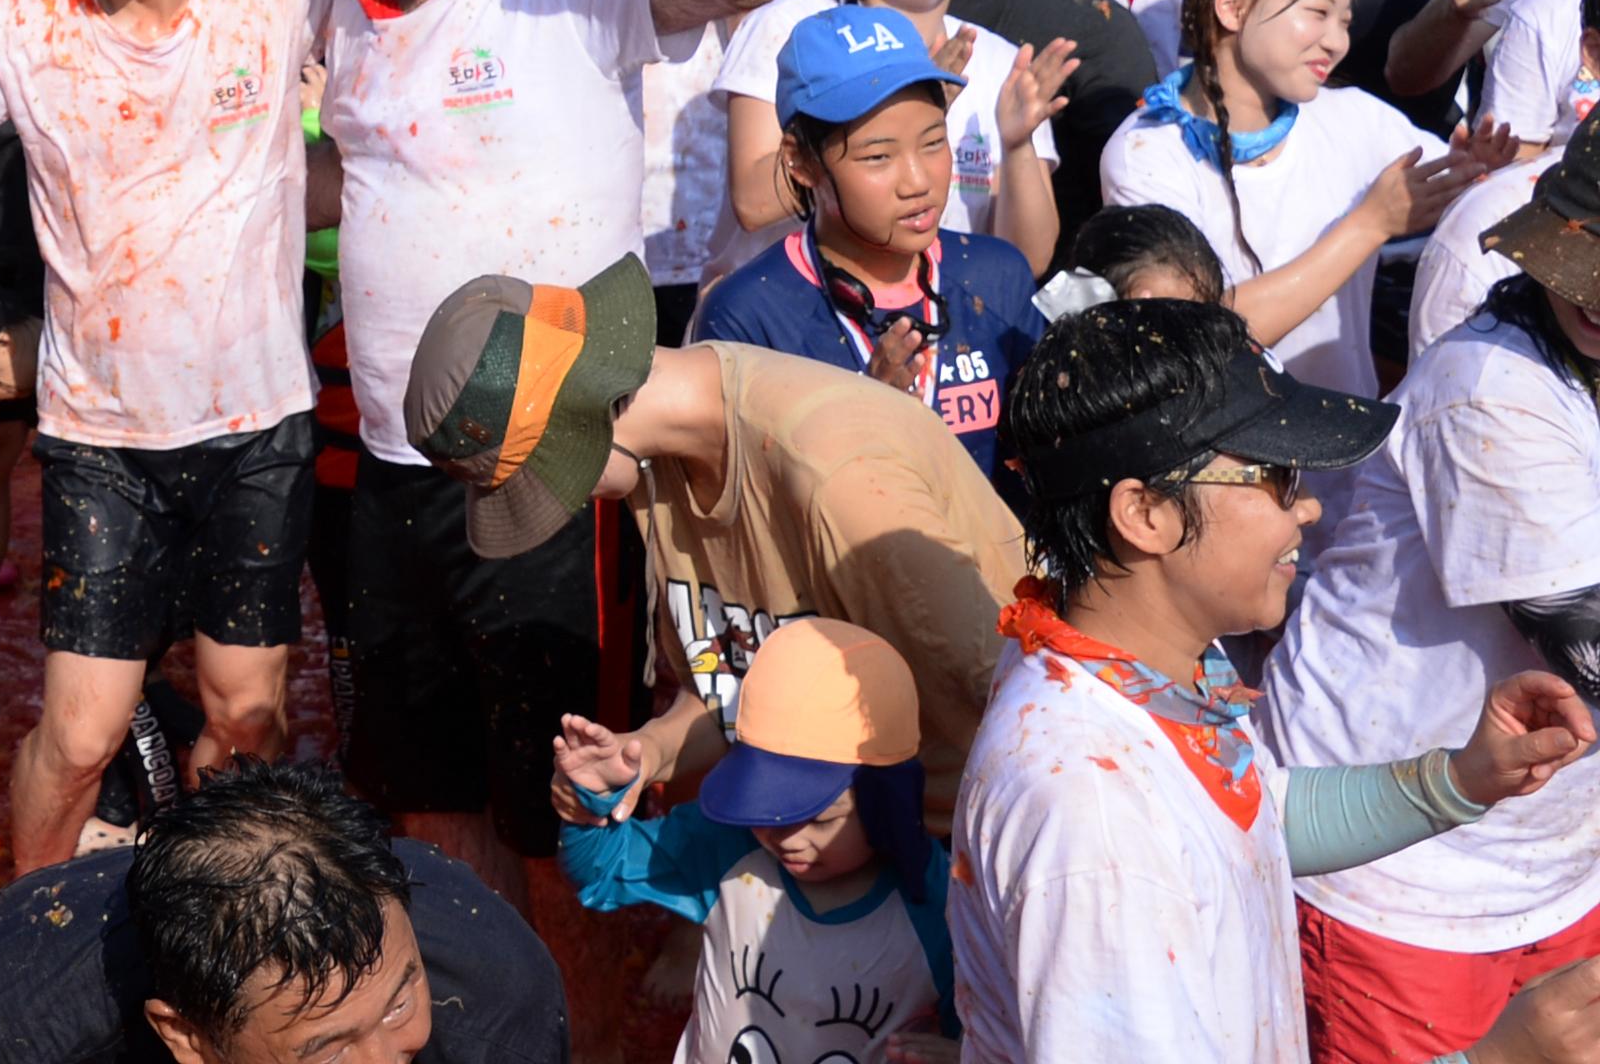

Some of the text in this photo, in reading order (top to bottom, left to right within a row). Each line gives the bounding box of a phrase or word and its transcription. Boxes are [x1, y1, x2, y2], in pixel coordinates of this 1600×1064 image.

[836, 22, 904, 54] LA
[448, 60, 498, 86] 토마토
[955, 350, 990, 383] 05
